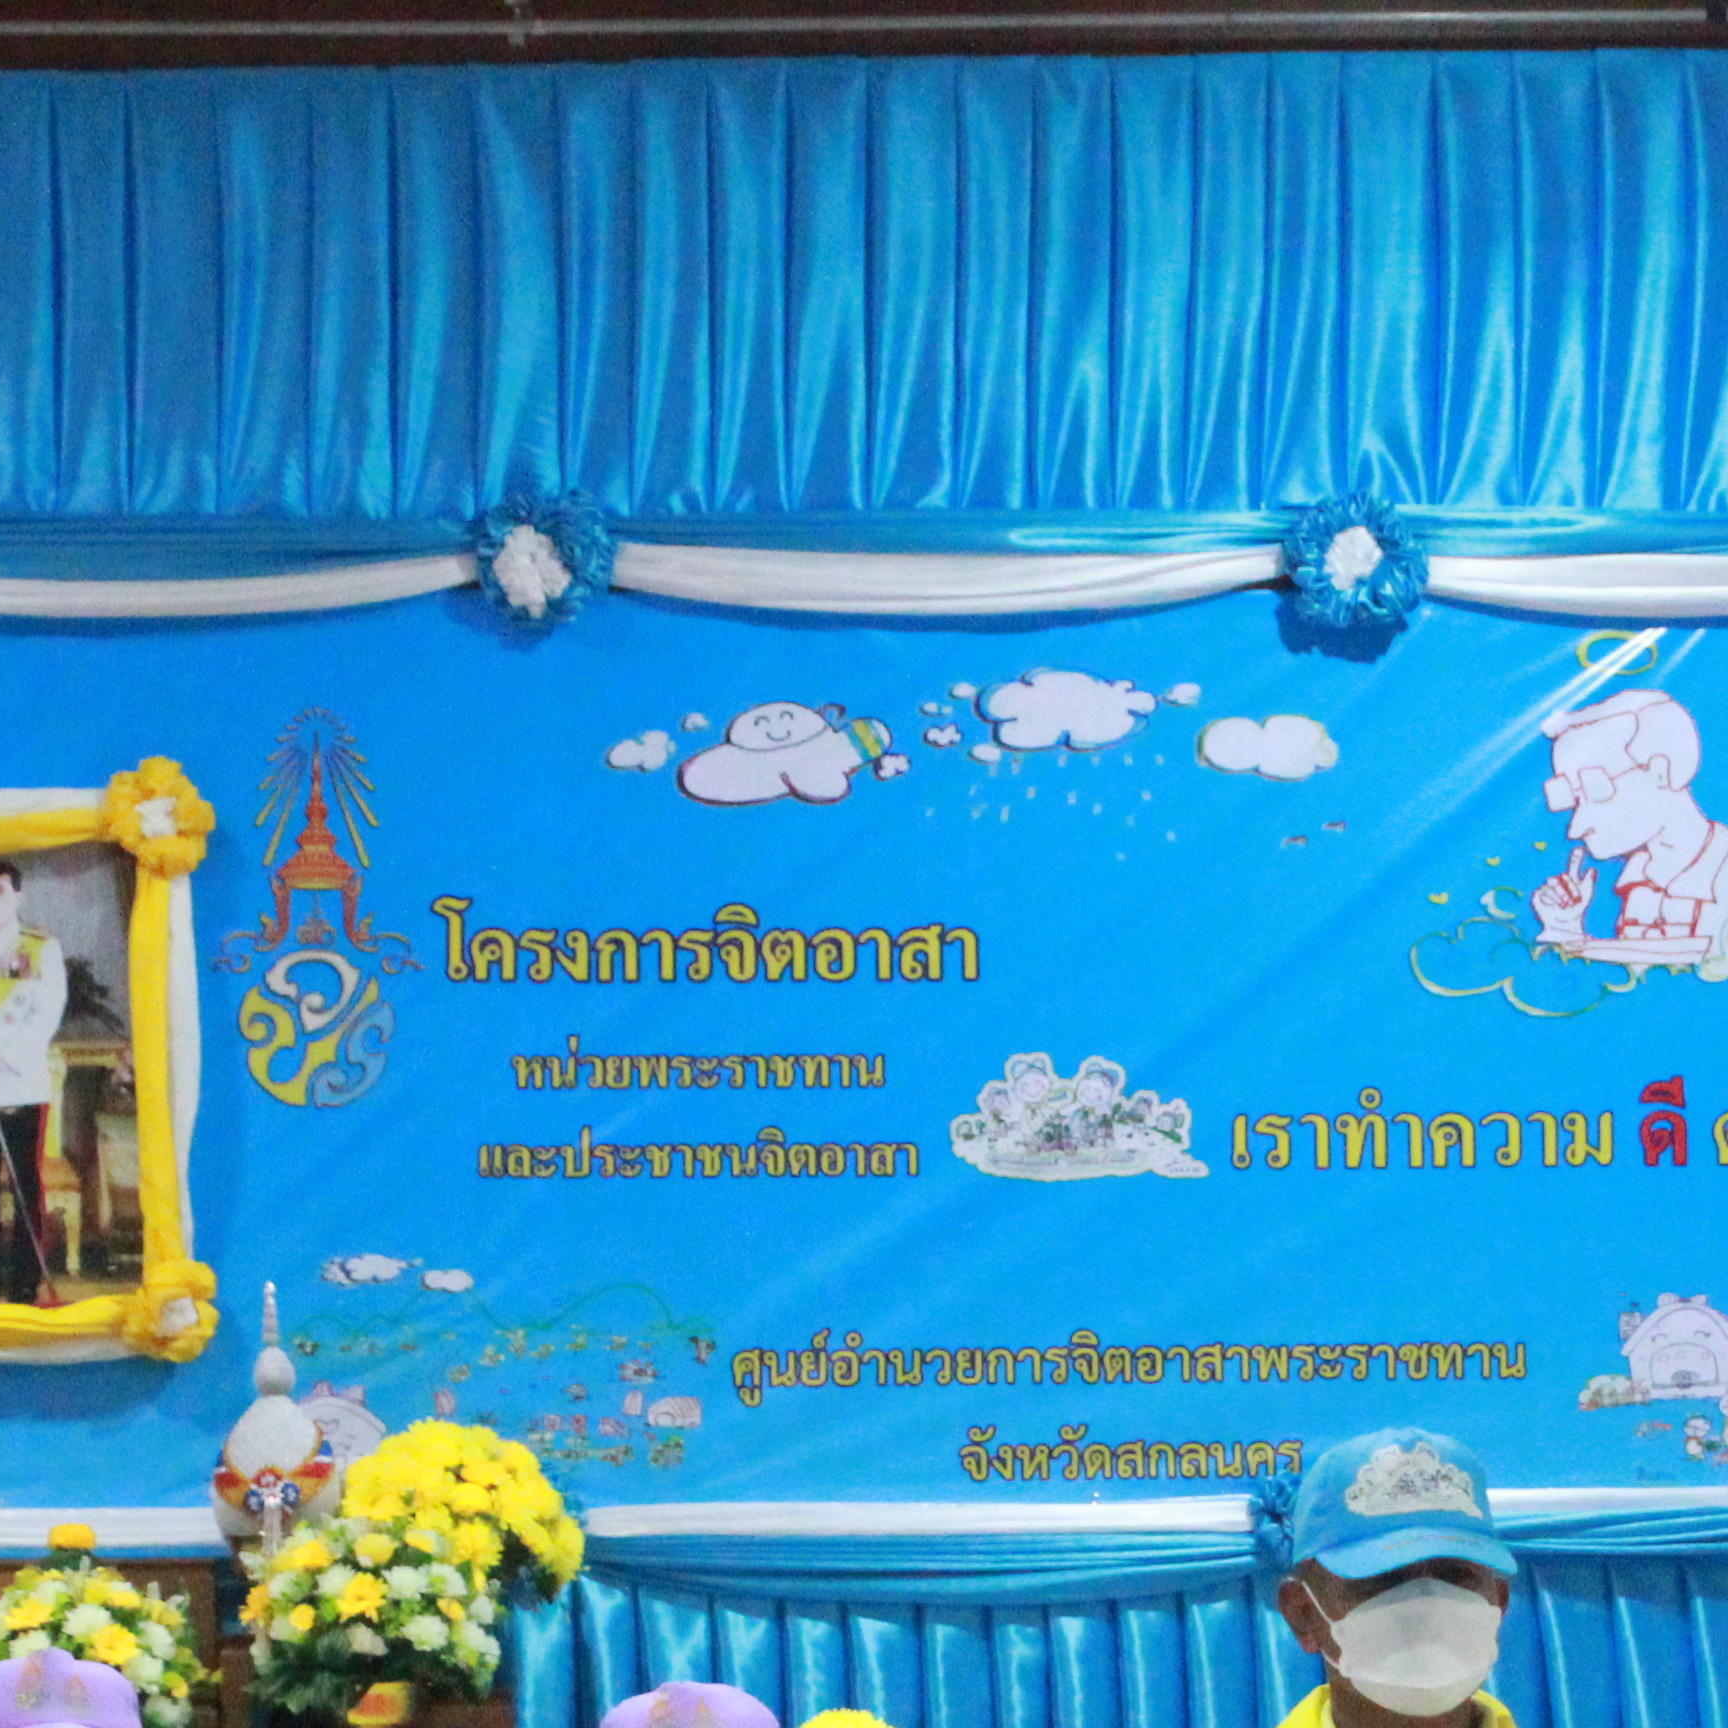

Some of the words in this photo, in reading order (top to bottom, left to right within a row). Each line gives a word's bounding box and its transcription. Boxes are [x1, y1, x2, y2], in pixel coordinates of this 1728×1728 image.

[430, 894, 981, 986] โครงการจิตอาสา
[510, 1034, 887, 1092] หน่วยพระราชทาน
[477, 1123, 921, 1180] และประชาชนจิตอาสา
[1230, 1086, 1616, 1171] เราทำความ
[1638, 1074, 1688, 1168] ดี
[730, 1327, 1528, 1408] ศูนย์อำนวยการจิตอาสาพระราชทาน
[958, 1423, 1303, 1484] จังหวัดสกลนคร
